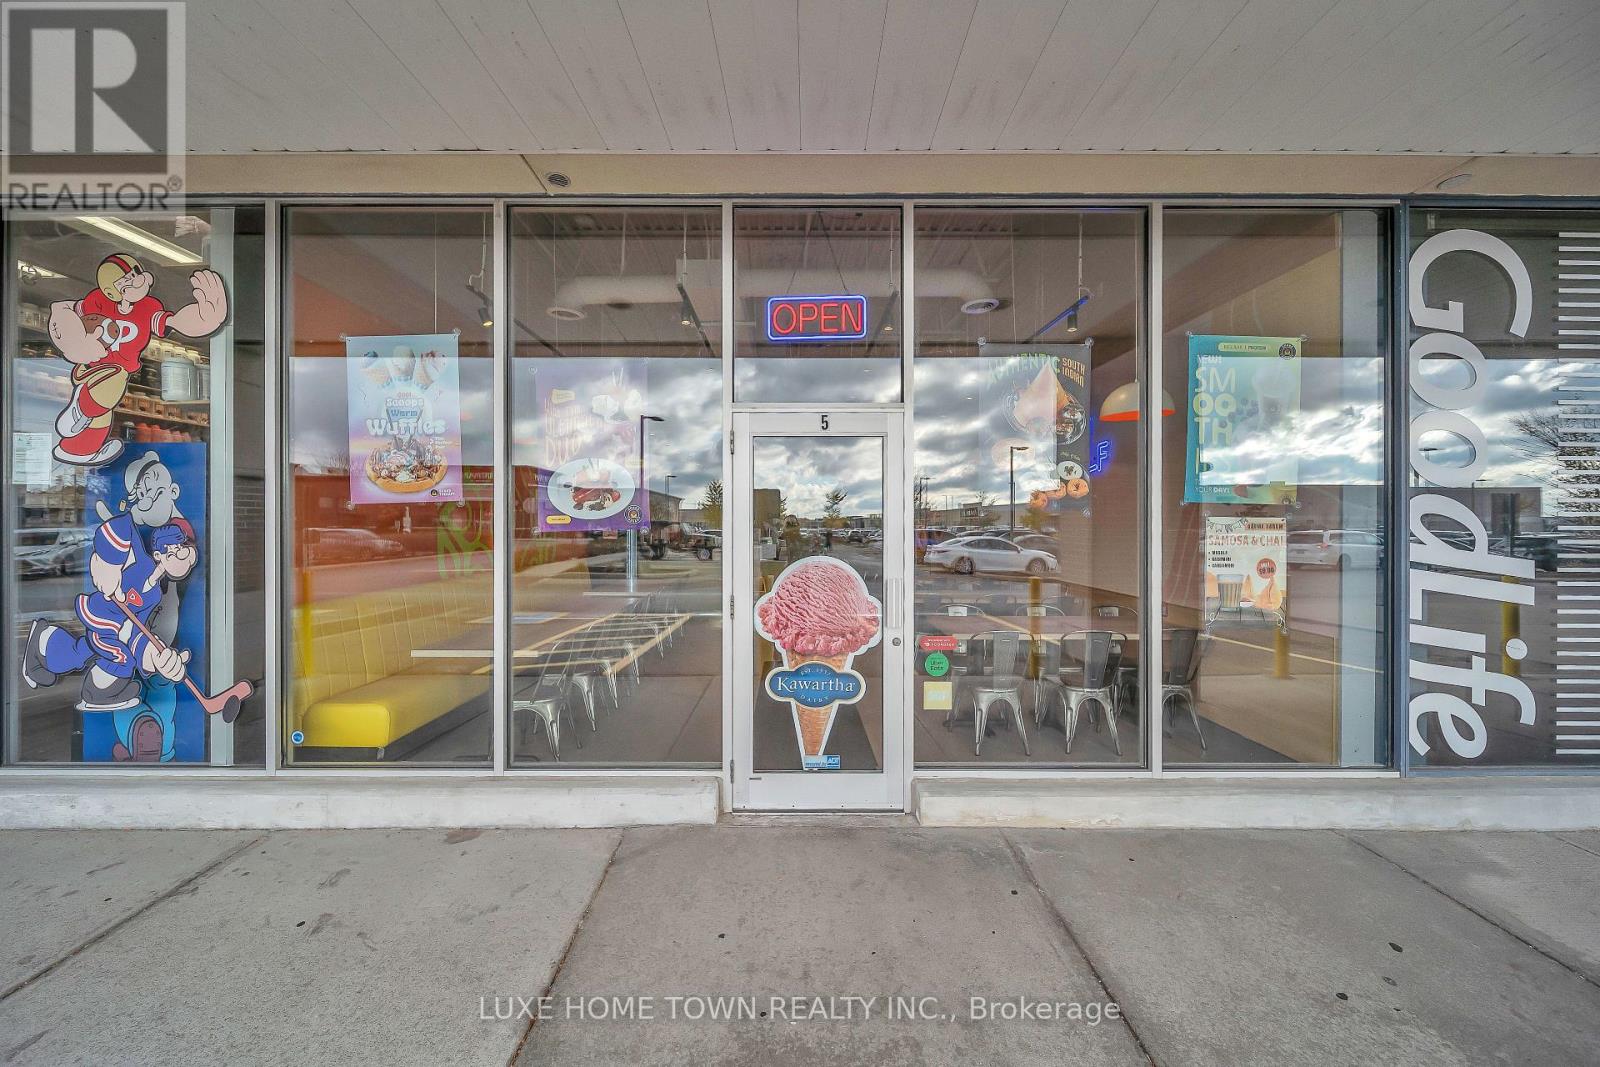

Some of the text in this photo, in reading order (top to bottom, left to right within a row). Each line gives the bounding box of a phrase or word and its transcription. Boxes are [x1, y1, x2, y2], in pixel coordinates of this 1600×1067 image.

[772, 302, 862, 334] OPEN
[1061, 357, 1086, 376] SOUTH
[821, 414, 829, 431] 5
[1408, 228, 1536, 759] GoodLife
[1208, 534, 1284, 547] SAMOSA & CHAI
[776, 676, 855, 693] Kawartha
